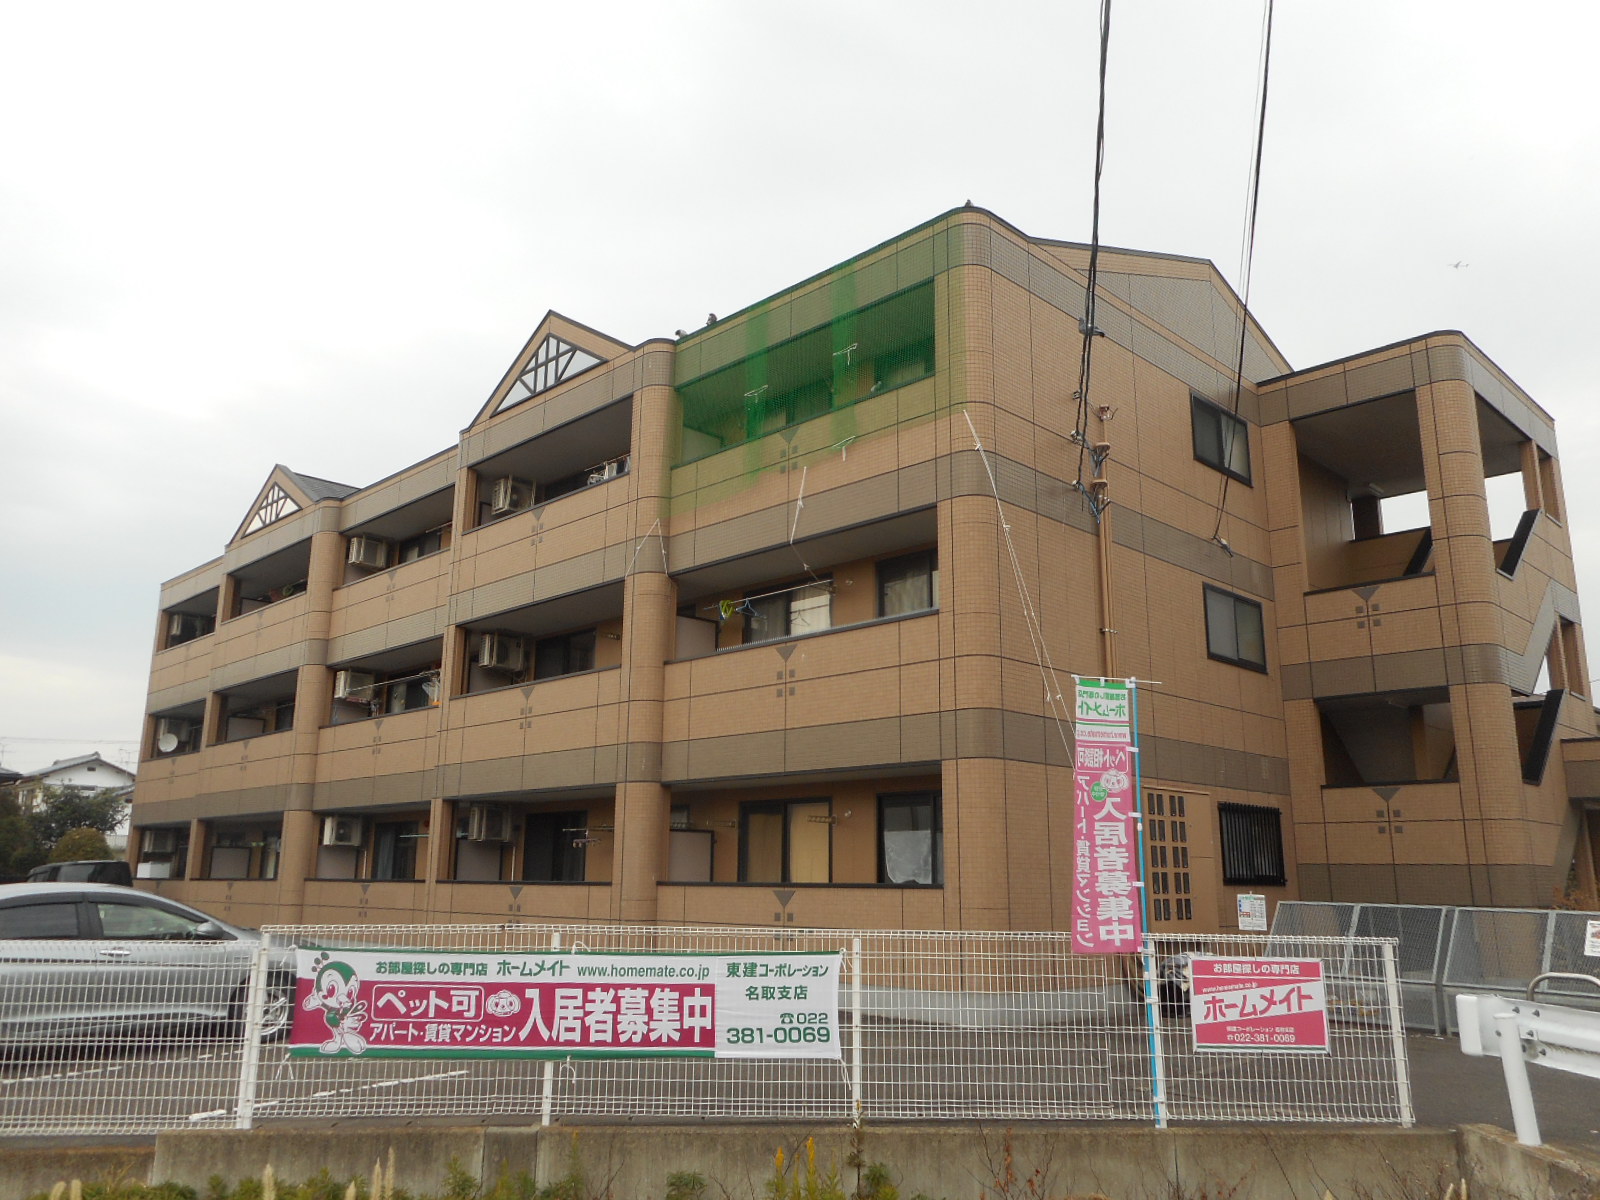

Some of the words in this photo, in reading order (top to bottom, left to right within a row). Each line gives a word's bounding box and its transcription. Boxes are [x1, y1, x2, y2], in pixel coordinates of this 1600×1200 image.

[375, 961, 488, 976] お部屋探しの専門店
[496, 959, 570, 977] ホームメイト
[576, 963, 710, 981] www.homemate.co.jp
[725, 961, 830, 979] 東建コーポレーション
[1213, 963, 1300, 975] お部屋探しの専門店
[744, 984, 808, 1002] 名取支店
[376, 988, 479, 1018] ペット可
[1203, 985, 1314, 1022] ホームメイト
[518, 987, 713, 1044] 入居者募集中
[796, 1013, 829, 1025] 022
[726, 1026, 832, 1045] 381-0069
